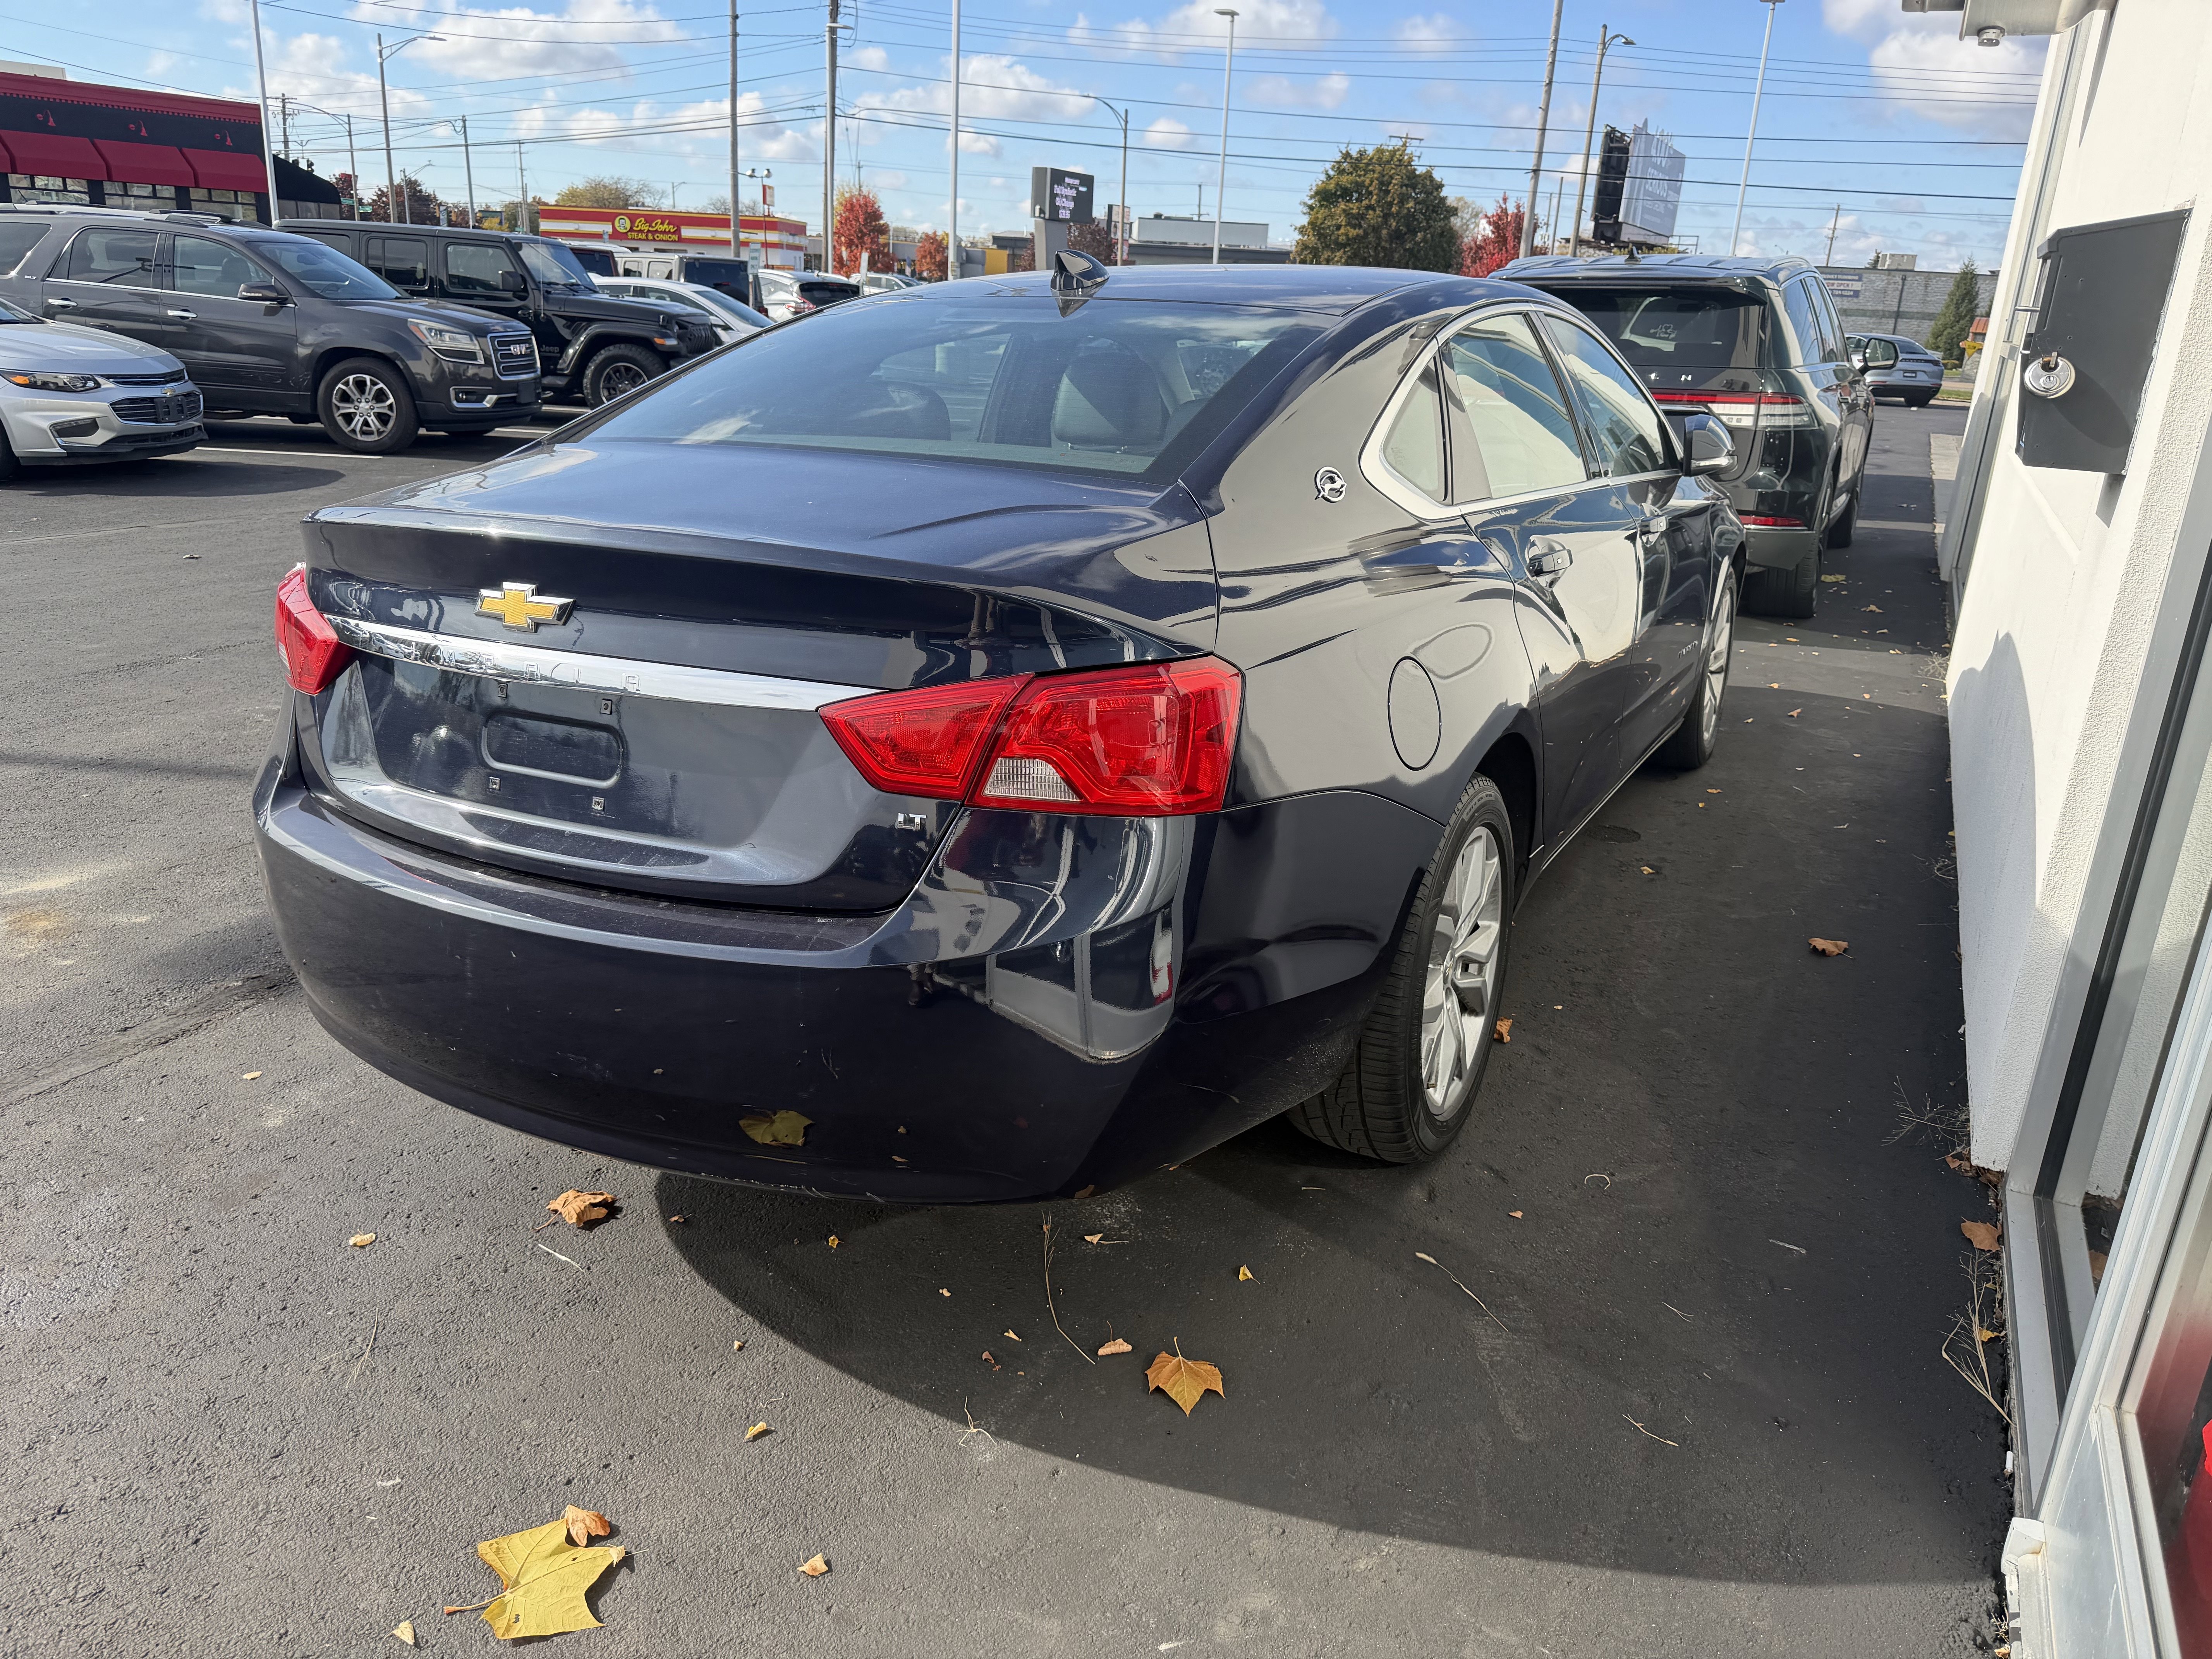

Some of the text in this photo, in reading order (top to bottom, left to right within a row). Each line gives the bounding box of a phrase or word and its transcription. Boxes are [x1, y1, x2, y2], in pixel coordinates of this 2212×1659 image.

[633, 217, 677, 232] Big John
[540, 344, 559, 353] Jeep
[898, 812, 927, 830] LT
